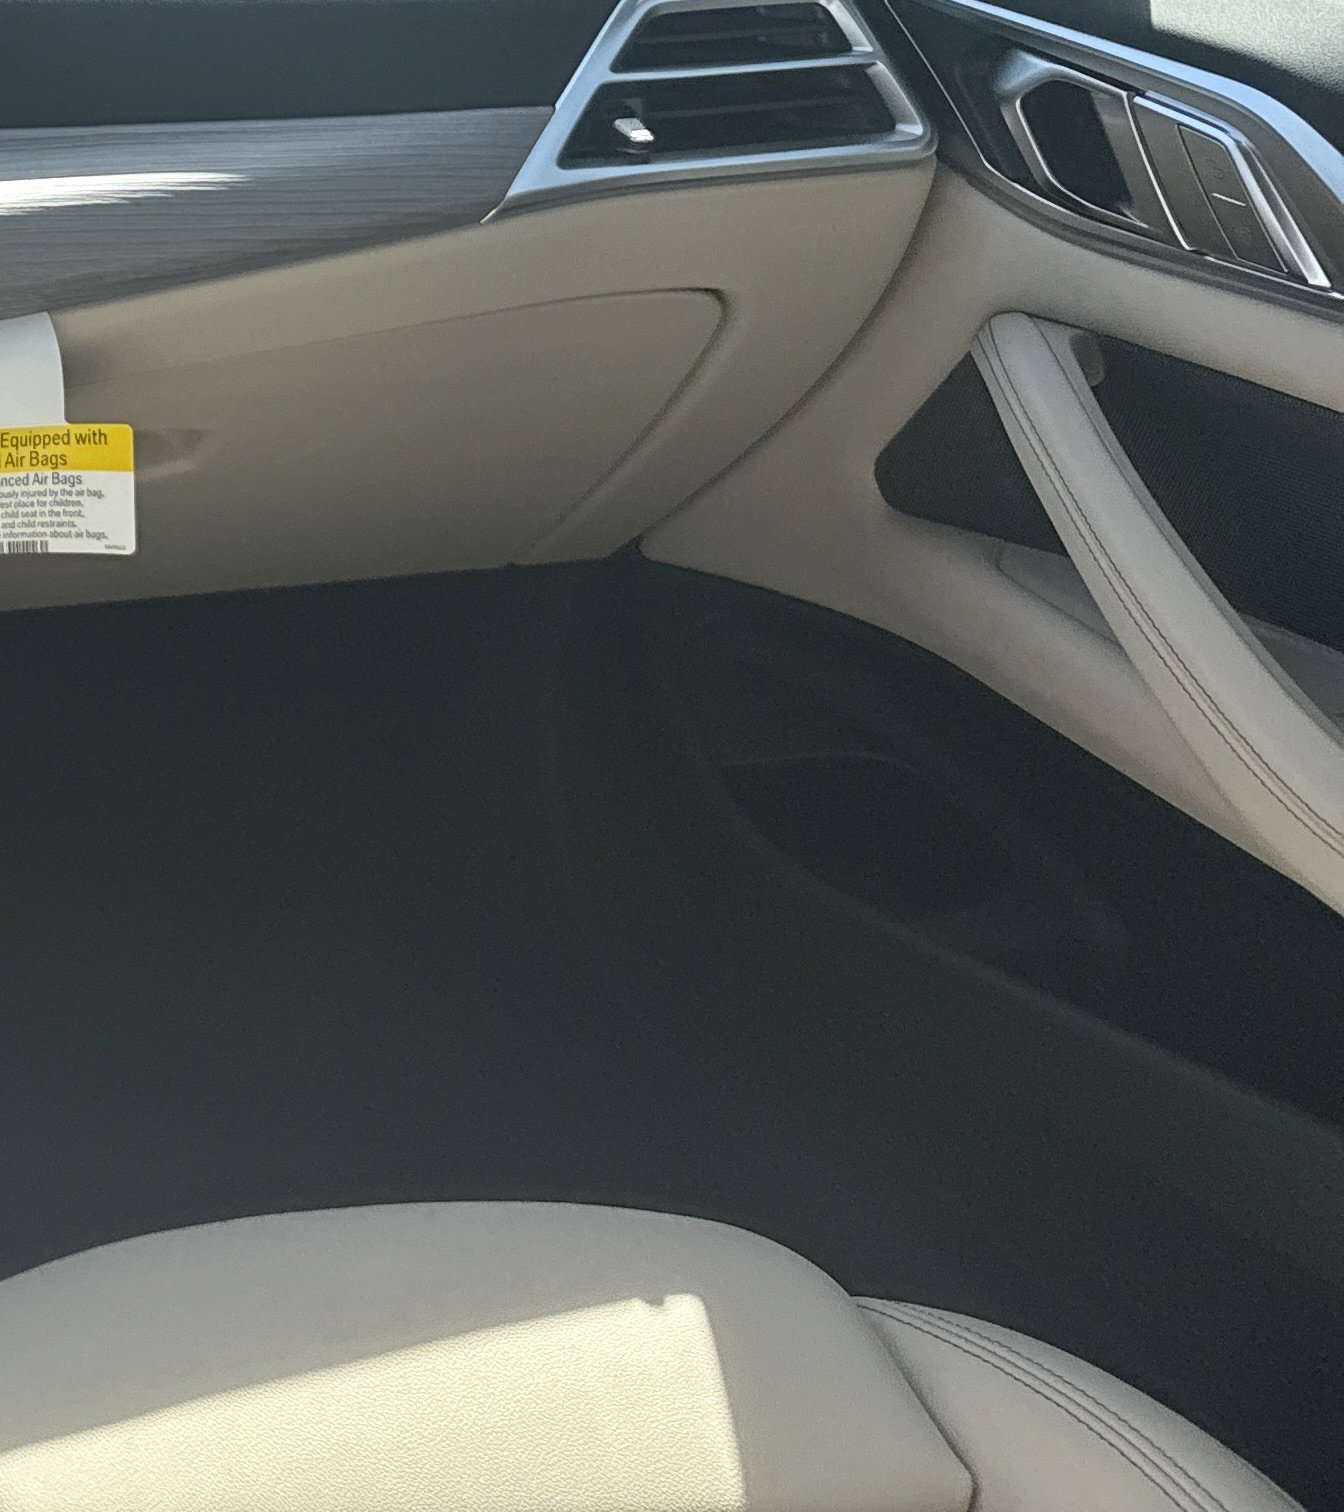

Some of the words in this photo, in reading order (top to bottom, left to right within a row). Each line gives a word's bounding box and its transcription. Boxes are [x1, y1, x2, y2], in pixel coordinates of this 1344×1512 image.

[0, 428, 71, 451] Equipped
[74, 428, 108, 446] with
[4, 452, 26, 469] Air
[29, 450, 68, 470] Bags
[31, 472, 49, 486] Air
[52, 471, 83, 487] Bags
[20, 488, 47, 499] injured
[48, 488, 59, 499] by
[59, 488, 73, 497] the
[74, 488, 85, 497] air
[86, 487, 105, 499] bag.
[14, 499, 35, 509] place
[36, 498, 48, 507] for
[49, 498, 84, 507] children.
[1, 510, 20, 519] child
[21, 508, 38, 518] seat
[39, 508, 47, 517] in
[47, 508, 61, 518] the
[1, 519, 16, 529] and
[17, 519, 36, 529] child
[2, 529, 48, 539] information
[48, 529, 73, 539] about
[74, 529, 84, 539] air
